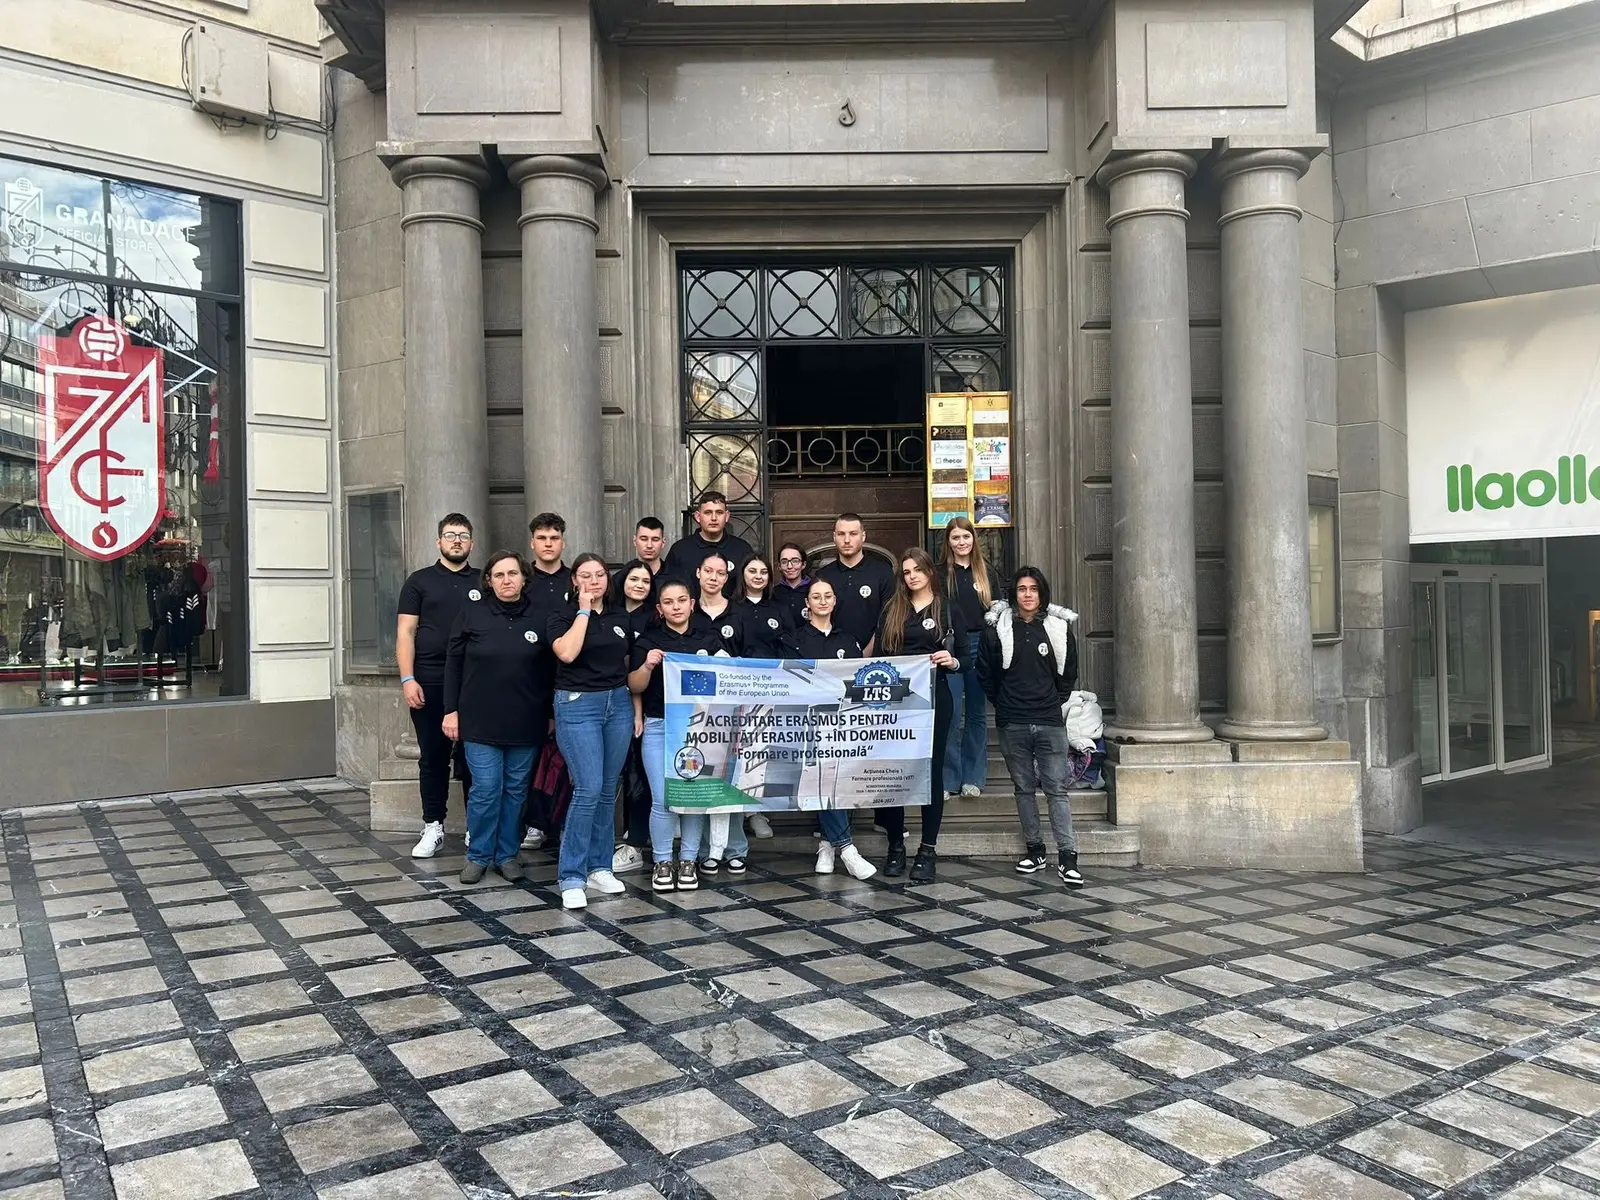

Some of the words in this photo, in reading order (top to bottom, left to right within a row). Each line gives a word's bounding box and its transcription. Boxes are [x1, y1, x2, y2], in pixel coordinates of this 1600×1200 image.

[115, 236, 154, 252] STORE
[719, 680, 751, 688] Erasmus+
[752, 681, 789, 690] Programme
[752, 674, 761, 682] by
[738, 689, 770, 698] European
[862, 686, 892, 701] LTS
[705, 715, 784, 727] ACREDITARE
[785, 715, 847, 727] ERASMUS
[850, 713, 898, 726] PENTRU
[761, 731, 822, 743] ERASMUS
[850, 729, 916, 741] DOMENIUL
